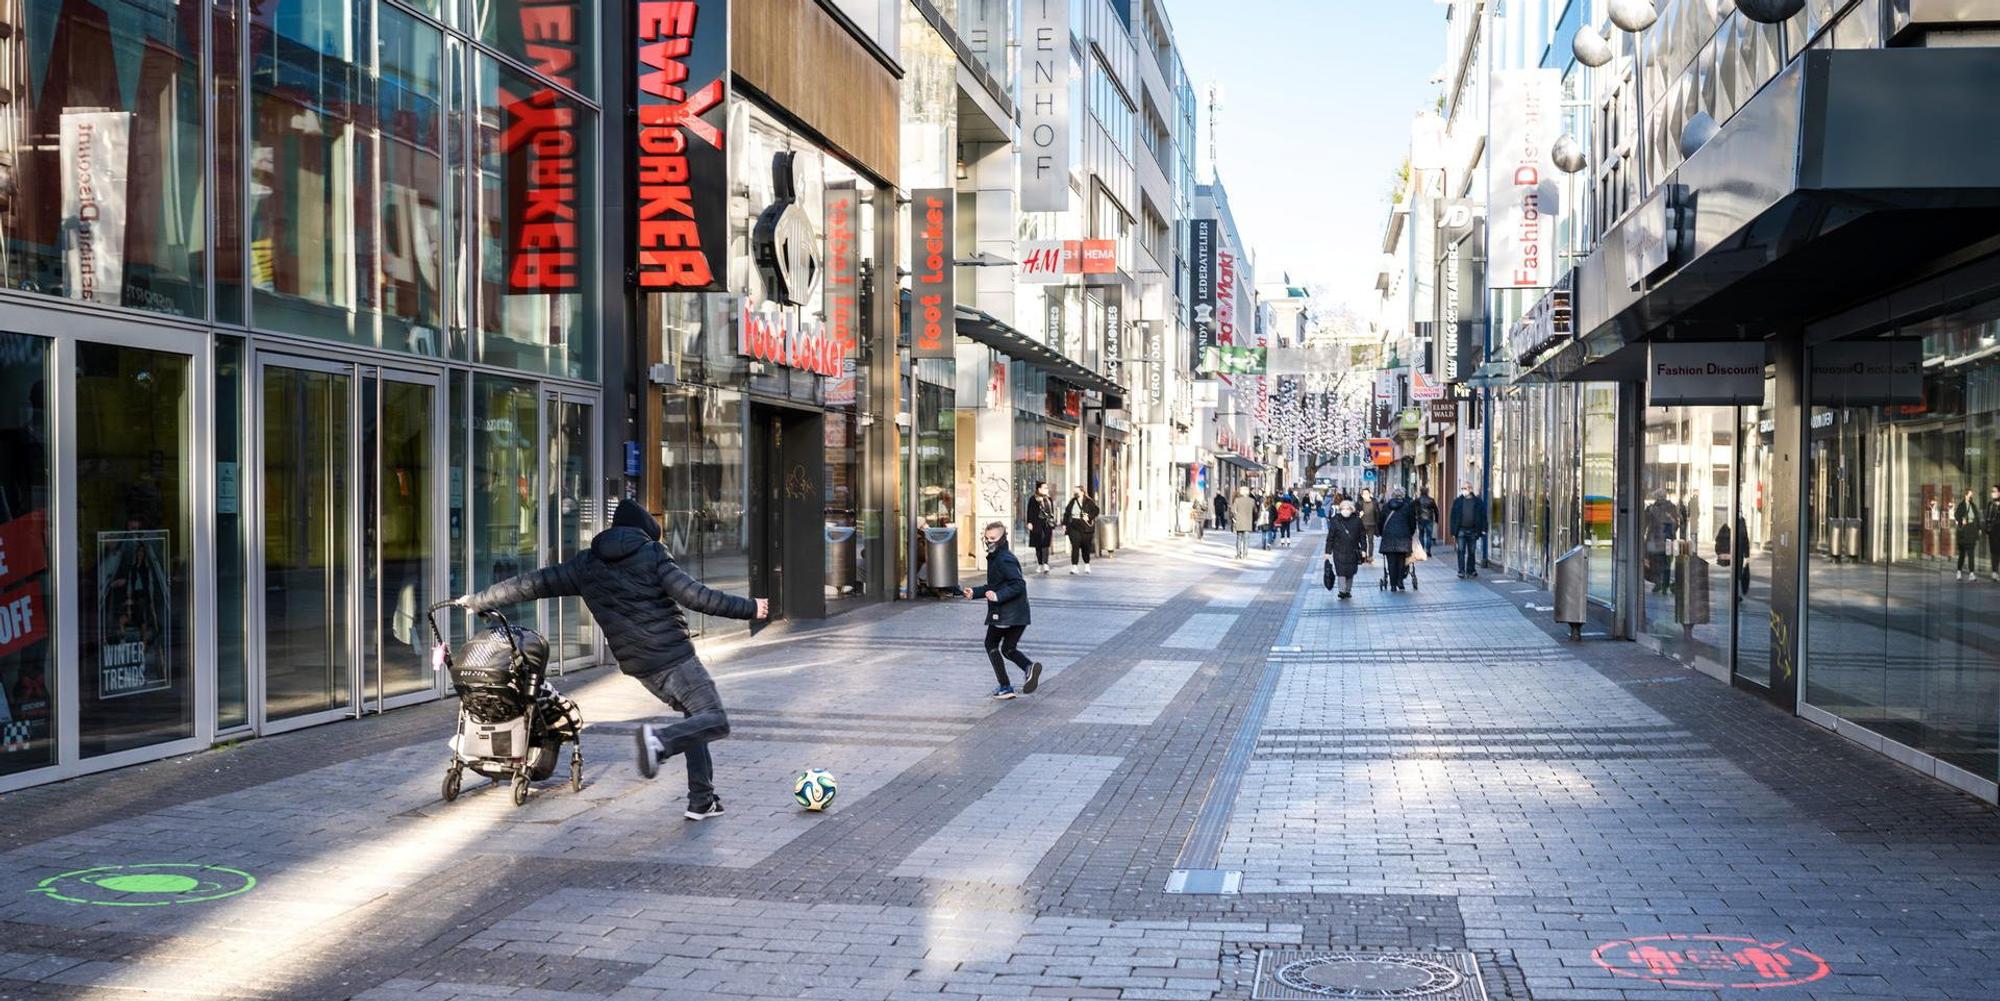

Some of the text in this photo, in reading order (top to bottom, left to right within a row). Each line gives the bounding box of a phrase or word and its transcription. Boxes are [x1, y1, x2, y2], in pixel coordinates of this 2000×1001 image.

[1438, 205, 1471, 228] JD
[920, 196, 945, 283] Locker
[1084, 249, 1115, 260] HEMA
[1514, 194, 1539, 286] Fashion
[1022, 248, 1060, 274] H&M
[1199, 221, 1208, 299] LEDERATELIER
[1217, 251, 1234, 306] Markt
[1657, 362, 1759, 377] Fashion Discount
[1151, 373, 1160, 406] VERO
[0, 595, 32, 645] OFF
[103, 641, 145, 667] WINTER
[103, 665, 145, 692] TRENDS
